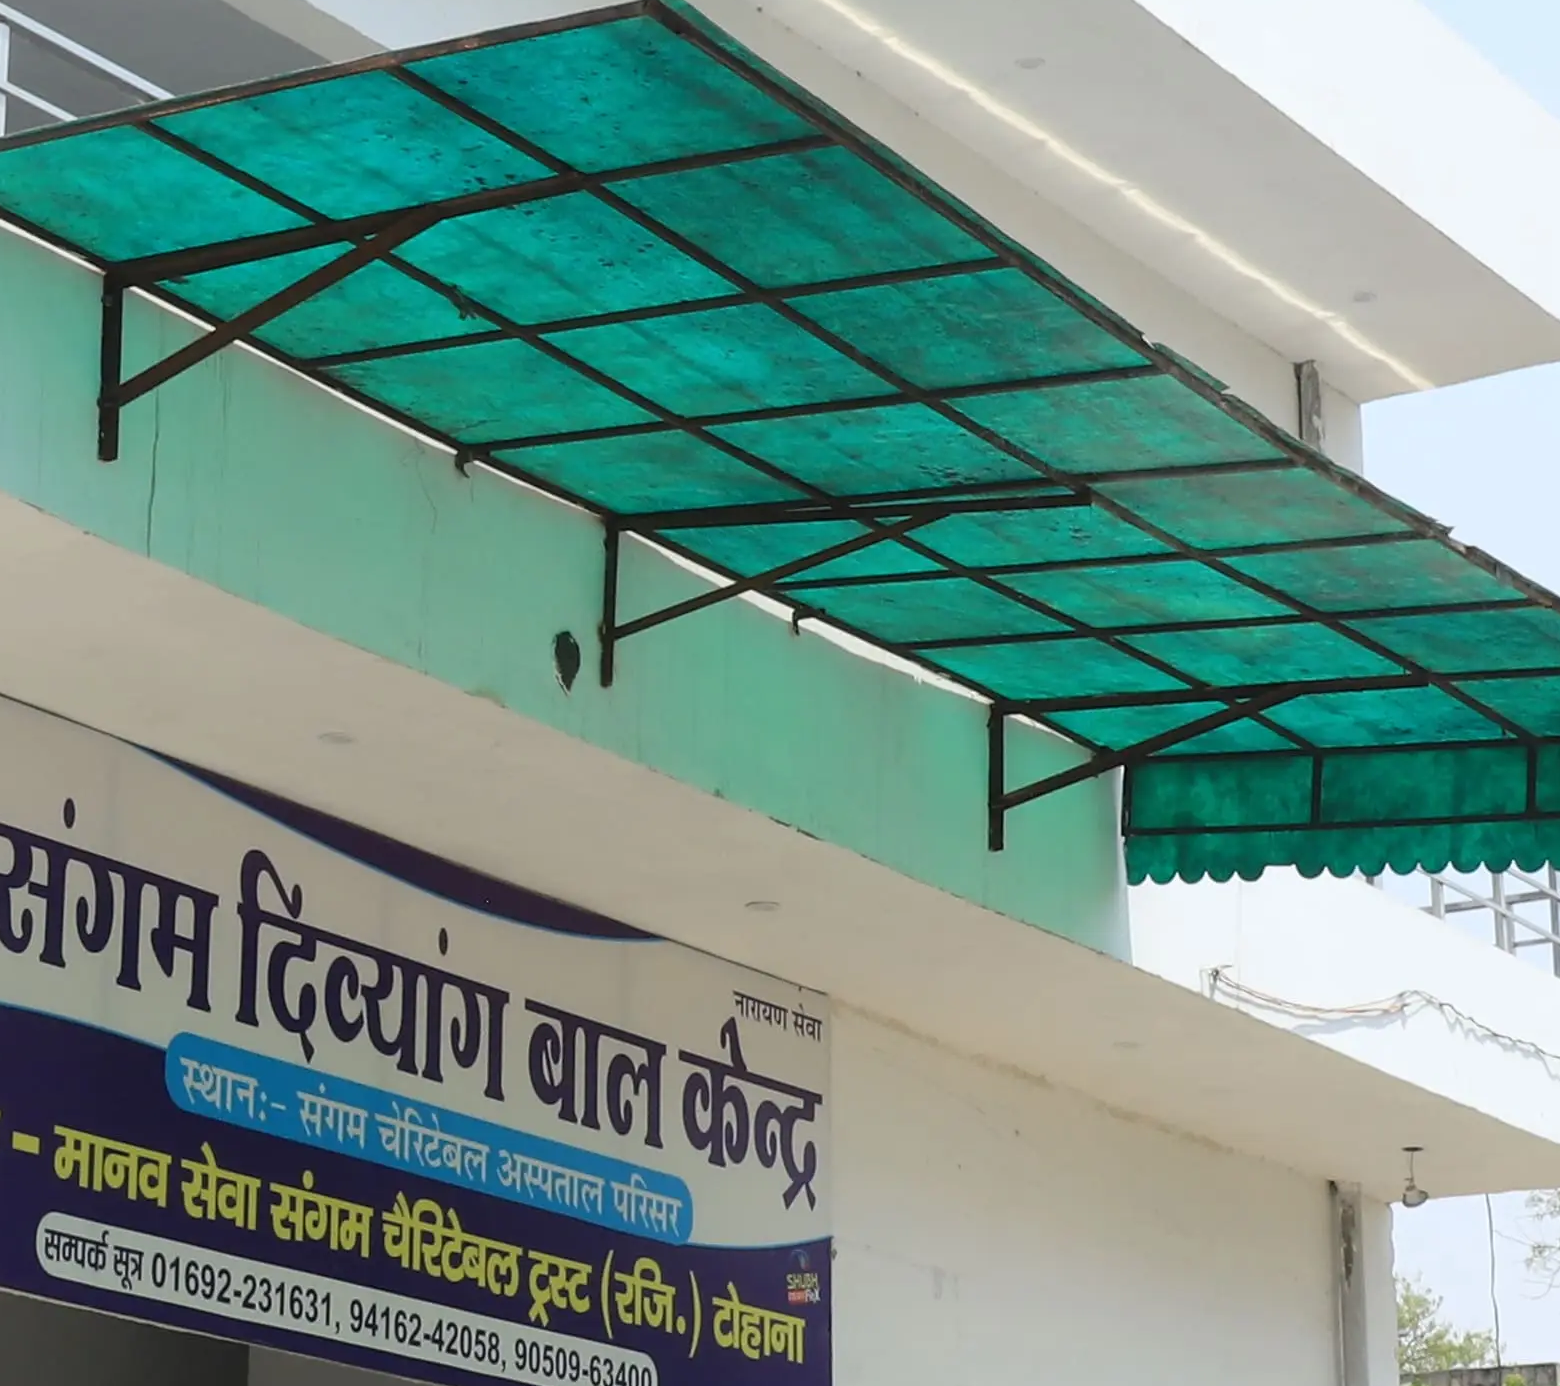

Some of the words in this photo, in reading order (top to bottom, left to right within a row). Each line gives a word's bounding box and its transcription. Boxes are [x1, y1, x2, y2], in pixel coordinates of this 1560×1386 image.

[234, 848, 511, 1102] दिव्यांग
[524, 997, 668, 1150] बाल
[678, 1015, 824, 1212] केन्द्र
[733, 989, 788, 1032] नारायण
[792, 1002, 823, 1043] सेवा
[296, 1081, 369, 1150] संगम
[374, 1100, 490, 1183] चेरिटेबल
[496, 1149, 605, 1214] अस्पताल
[610, 1173, 683, 1237] परिसर
[42, 1228, 111, 1274] सम्पर्क
[112, 1243, 144, 1292] सूत्र
[150, 1251, 342, 1336] 01692-231631,
[348, 1298, 508, 1373] 94162-42058,
[53, 1124, 172, 1208] मानव
[180, 1141, 261, 1231] सेवा
[269, 1169, 374, 1259] संगम
[381, 1190, 524, 1298] चैरिटेबल
[527, 1250, 593, 1328] ट्रस्ट
[711, 1281, 807, 1365] टोहाना
